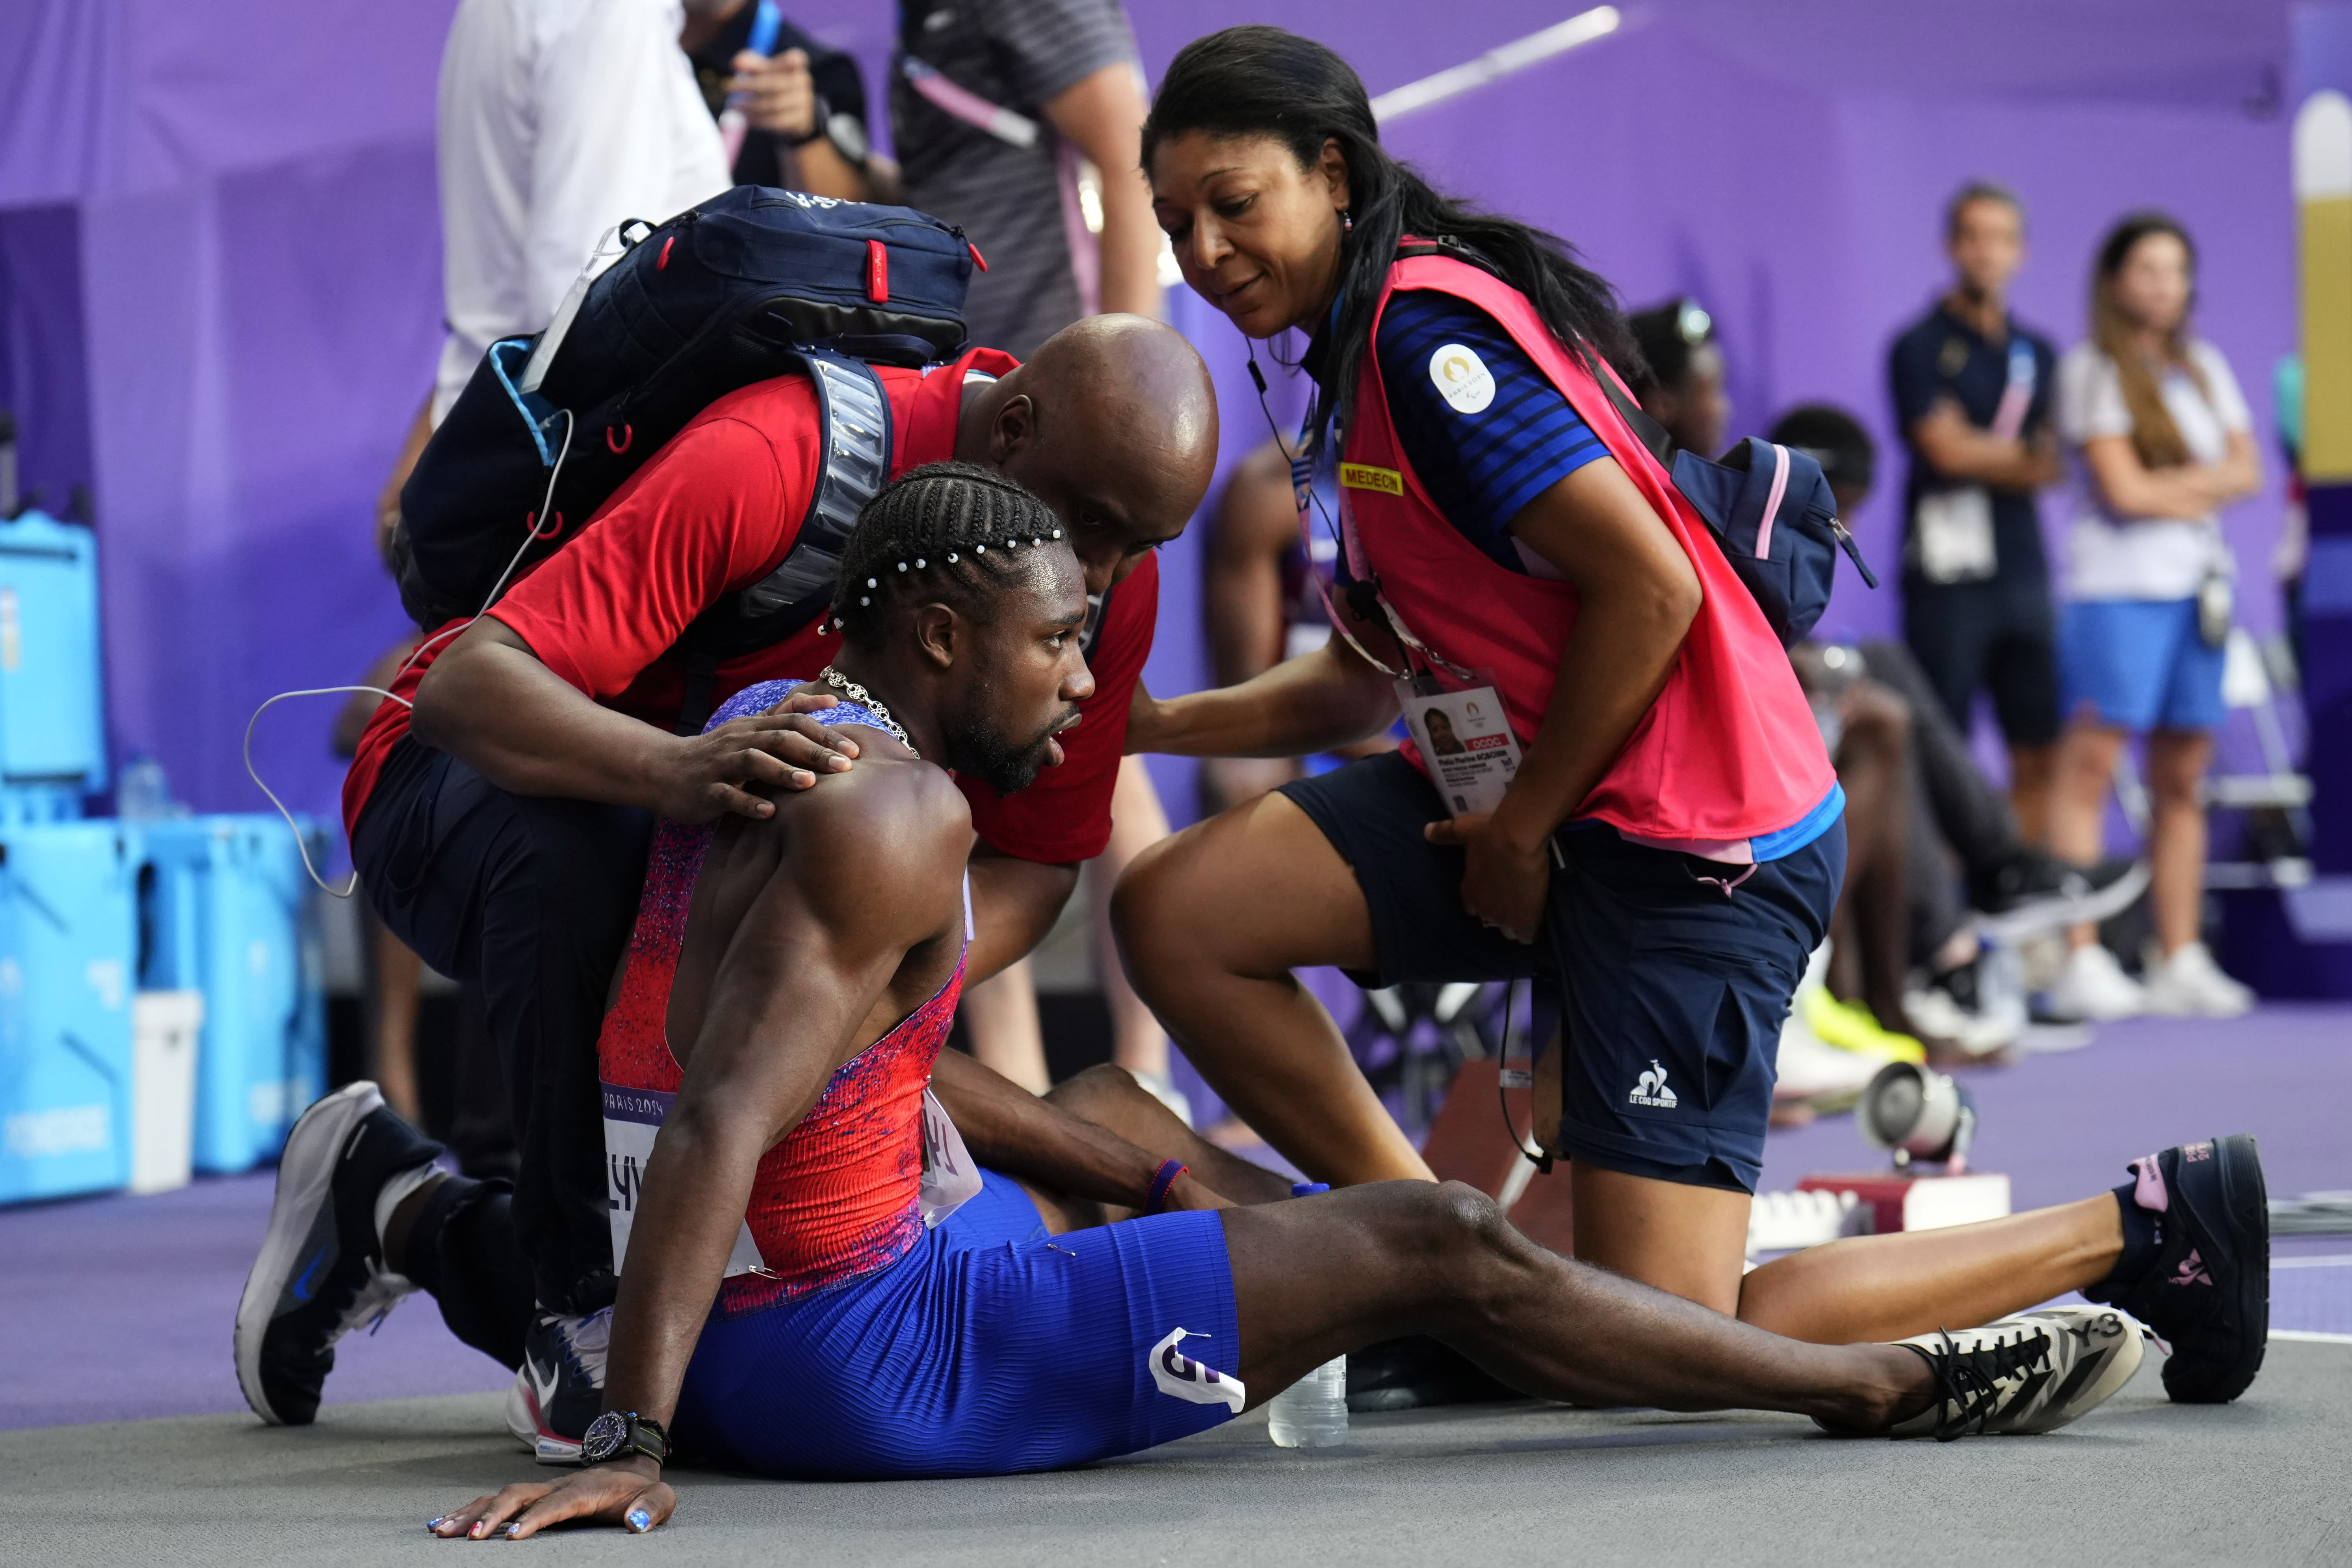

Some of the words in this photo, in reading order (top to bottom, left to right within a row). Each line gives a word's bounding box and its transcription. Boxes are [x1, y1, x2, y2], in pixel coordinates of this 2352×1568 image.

[1449, 384, 1468, 398] PARIS
[1468, 372, 1485, 385] 2024
[1346, 469, 1398, 492] MEDECIN
[605, 1092, 633, 1111] PARIS
[636, 1098, 663, 1116] 2024
[1629, 1095, 1638, 1104] LE
[1639, 1096, 1652, 1105] COQ
[1652, 1097, 1678, 1108] SPORTIF
[2067, 1313, 2123, 1348] Y-3
